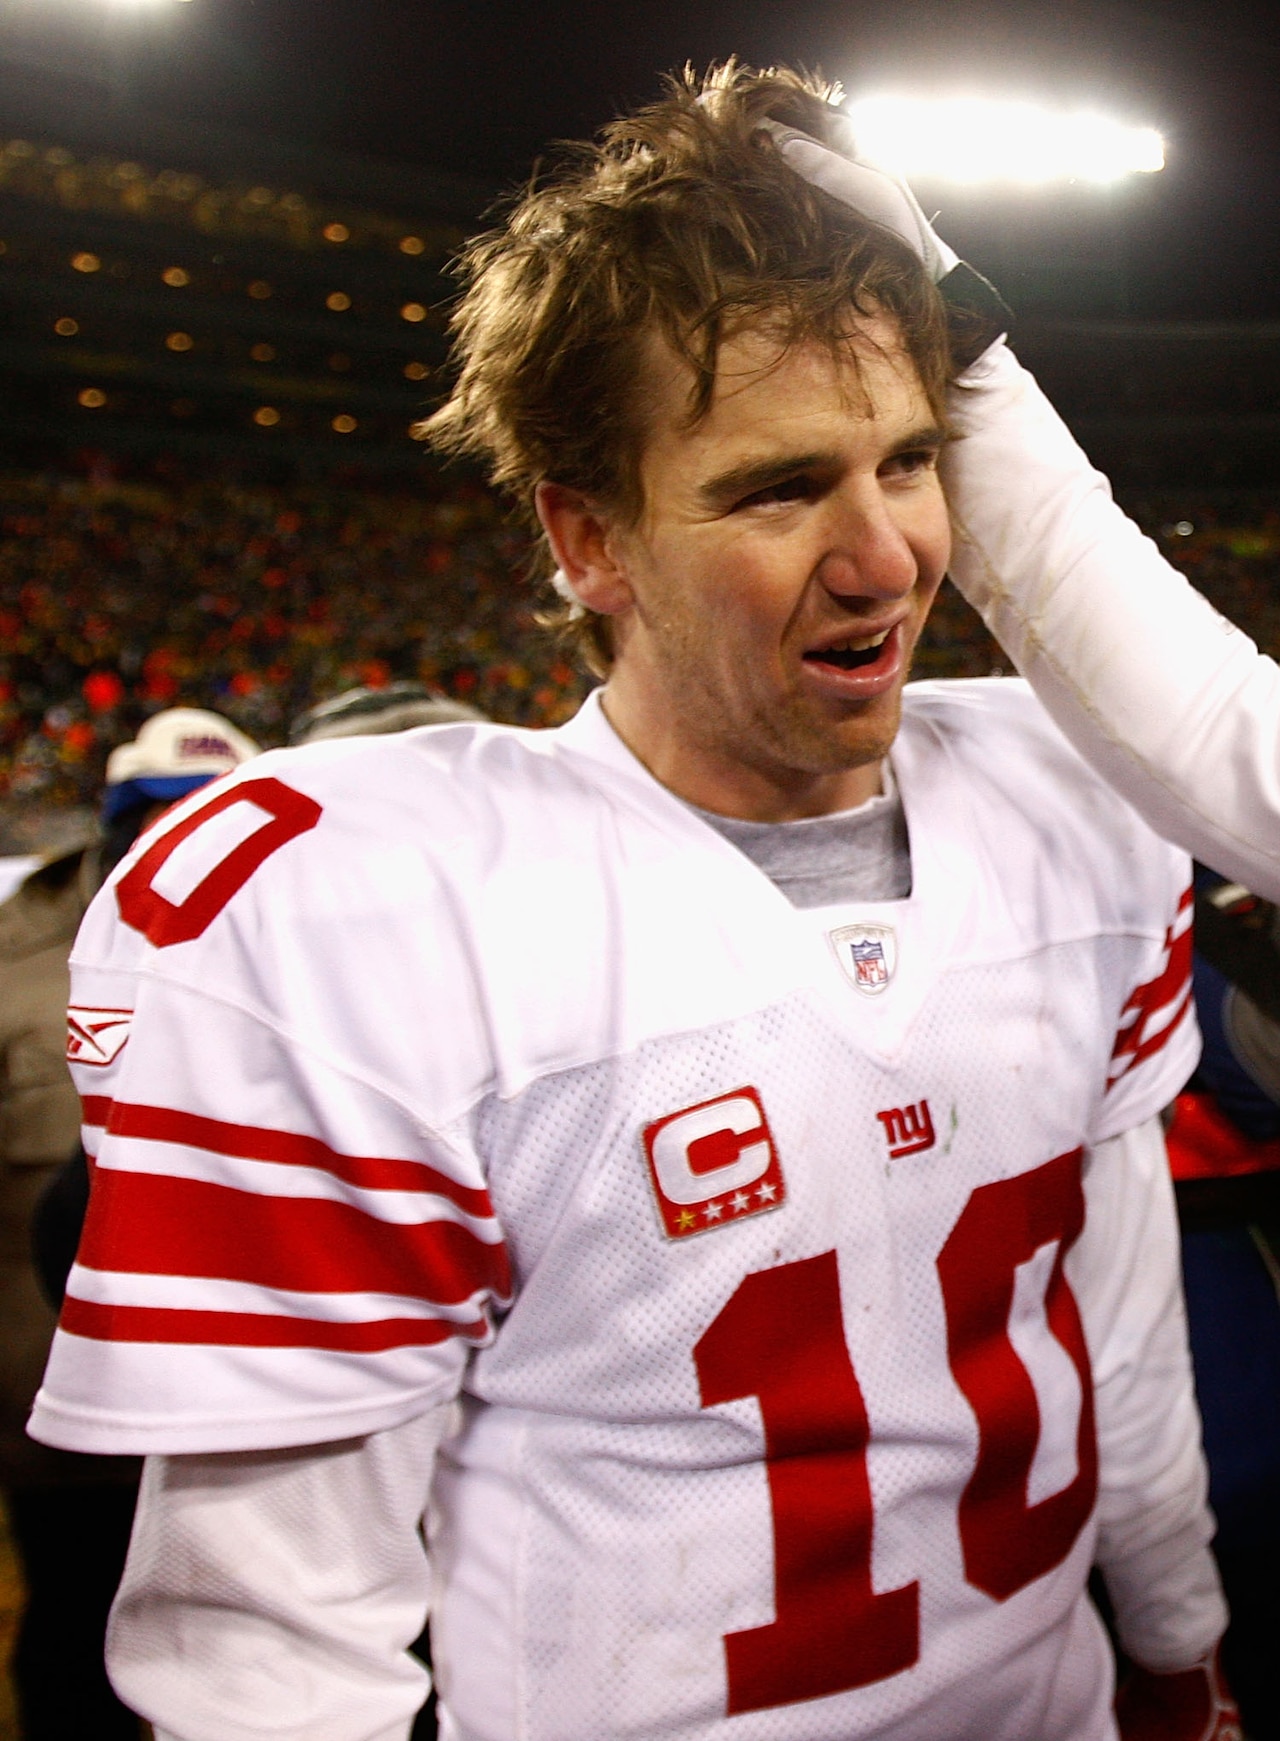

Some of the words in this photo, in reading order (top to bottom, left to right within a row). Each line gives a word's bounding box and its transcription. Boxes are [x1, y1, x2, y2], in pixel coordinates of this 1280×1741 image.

[855, 958, 888, 984] NFL
[651, 1096, 771, 1205] C
[693, 1174, 1098, 1717] 10
